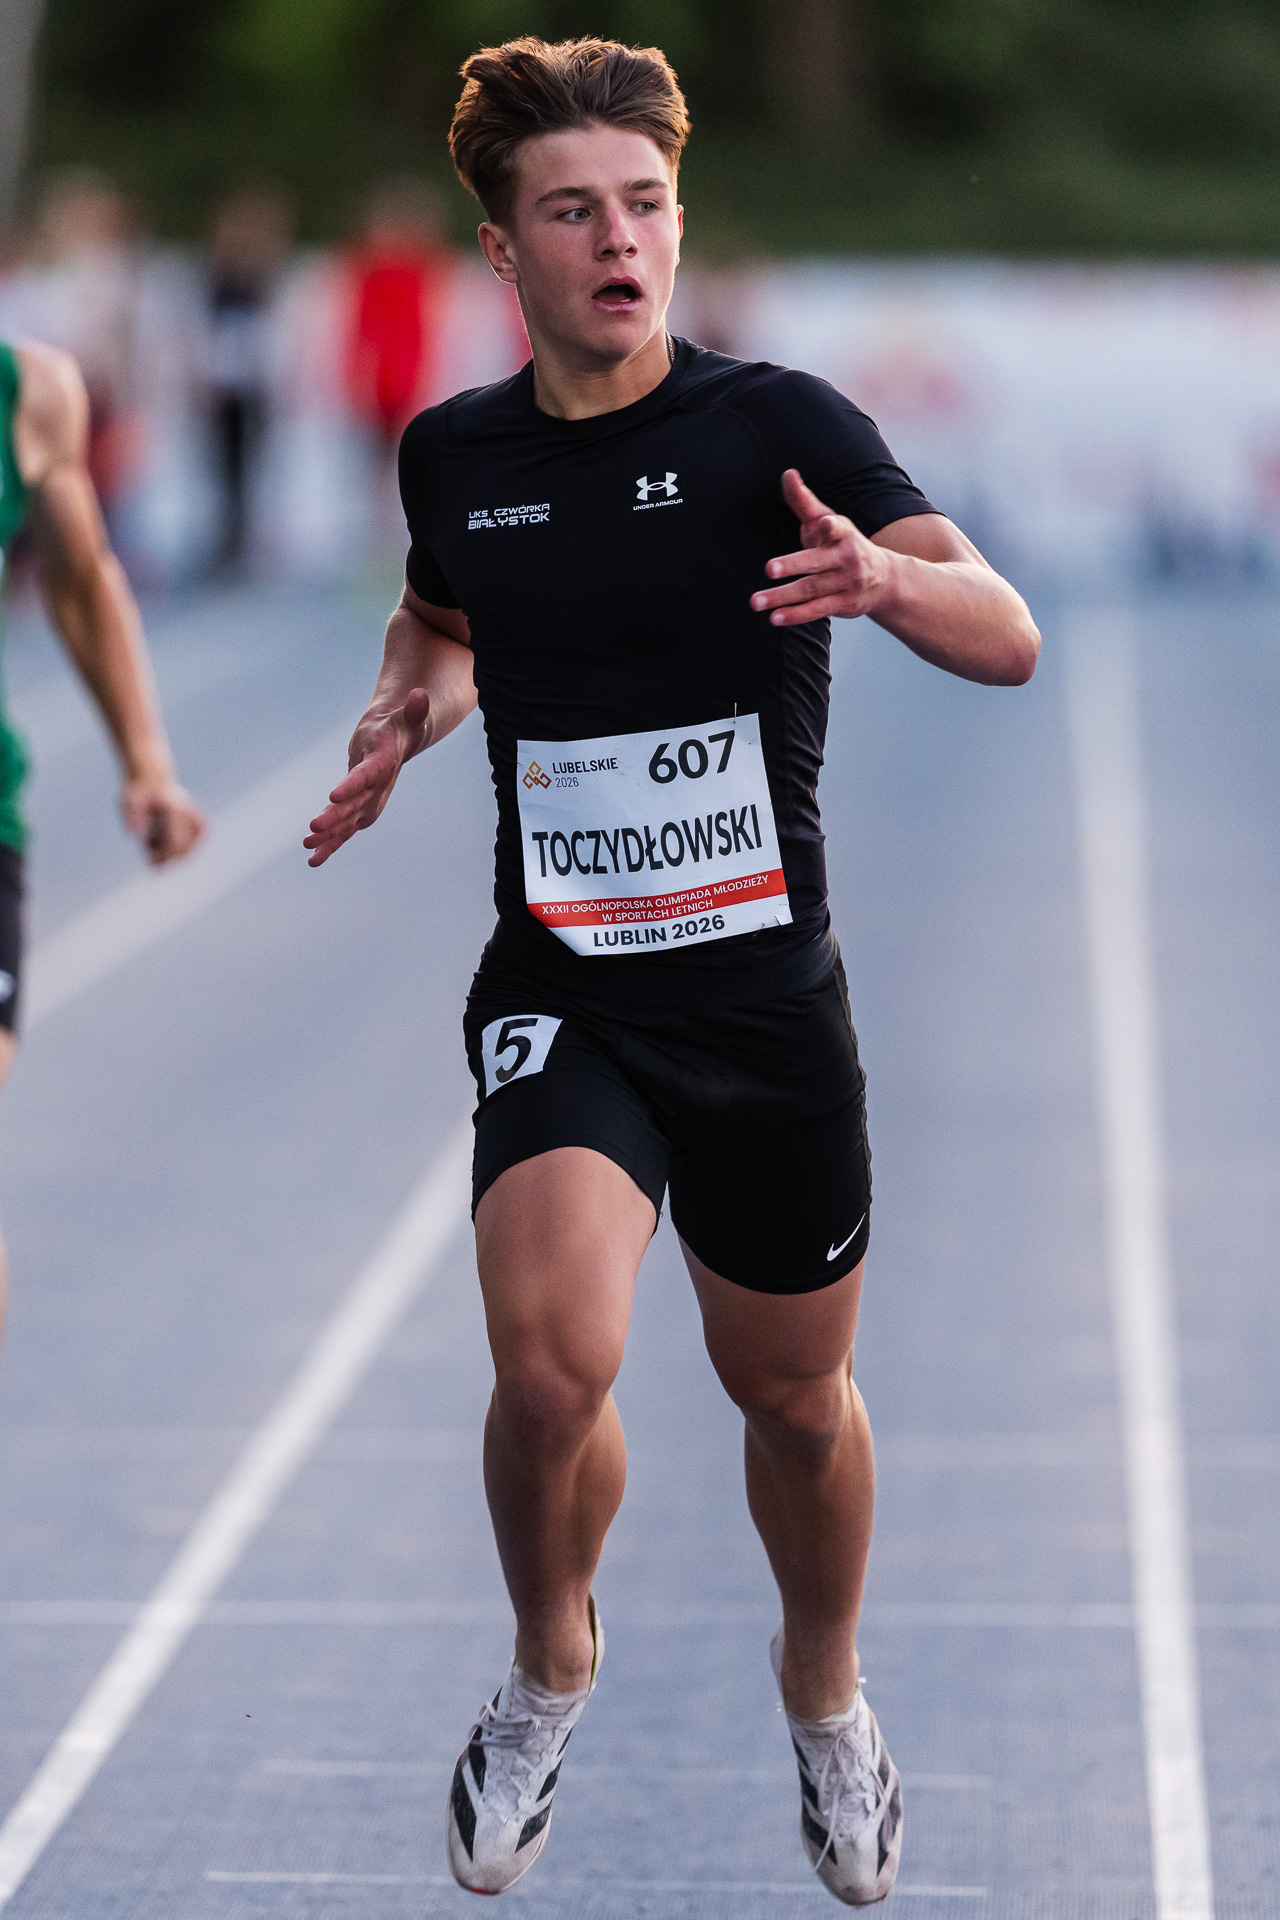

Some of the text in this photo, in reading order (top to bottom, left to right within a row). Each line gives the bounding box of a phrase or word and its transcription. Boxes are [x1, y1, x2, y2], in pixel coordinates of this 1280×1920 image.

[469, 503, 550, 519] UKS CZWÓRKA
[633, 498, 683, 511] UNDER ARMOUR
[468, 512, 550, 530] BIAŁYSTOK
[552, 757, 618, 774] LUBELSKIE
[649, 730, 736, 784] 607
[555, 776, 579, 788] 2026
[532, 804, 762, 877] TOCZYDŁOWSKI
[542, 874, 769, 915] XXXII OGÓLNOPOLSKA OLIMPIADA MŁODZIEŻY
[601, 899, 714, 923] W SPORTACH LETNICH
[593, 914, 725, 947] LUBLIN 2026
[495, 1018, 539, 1083] 5
